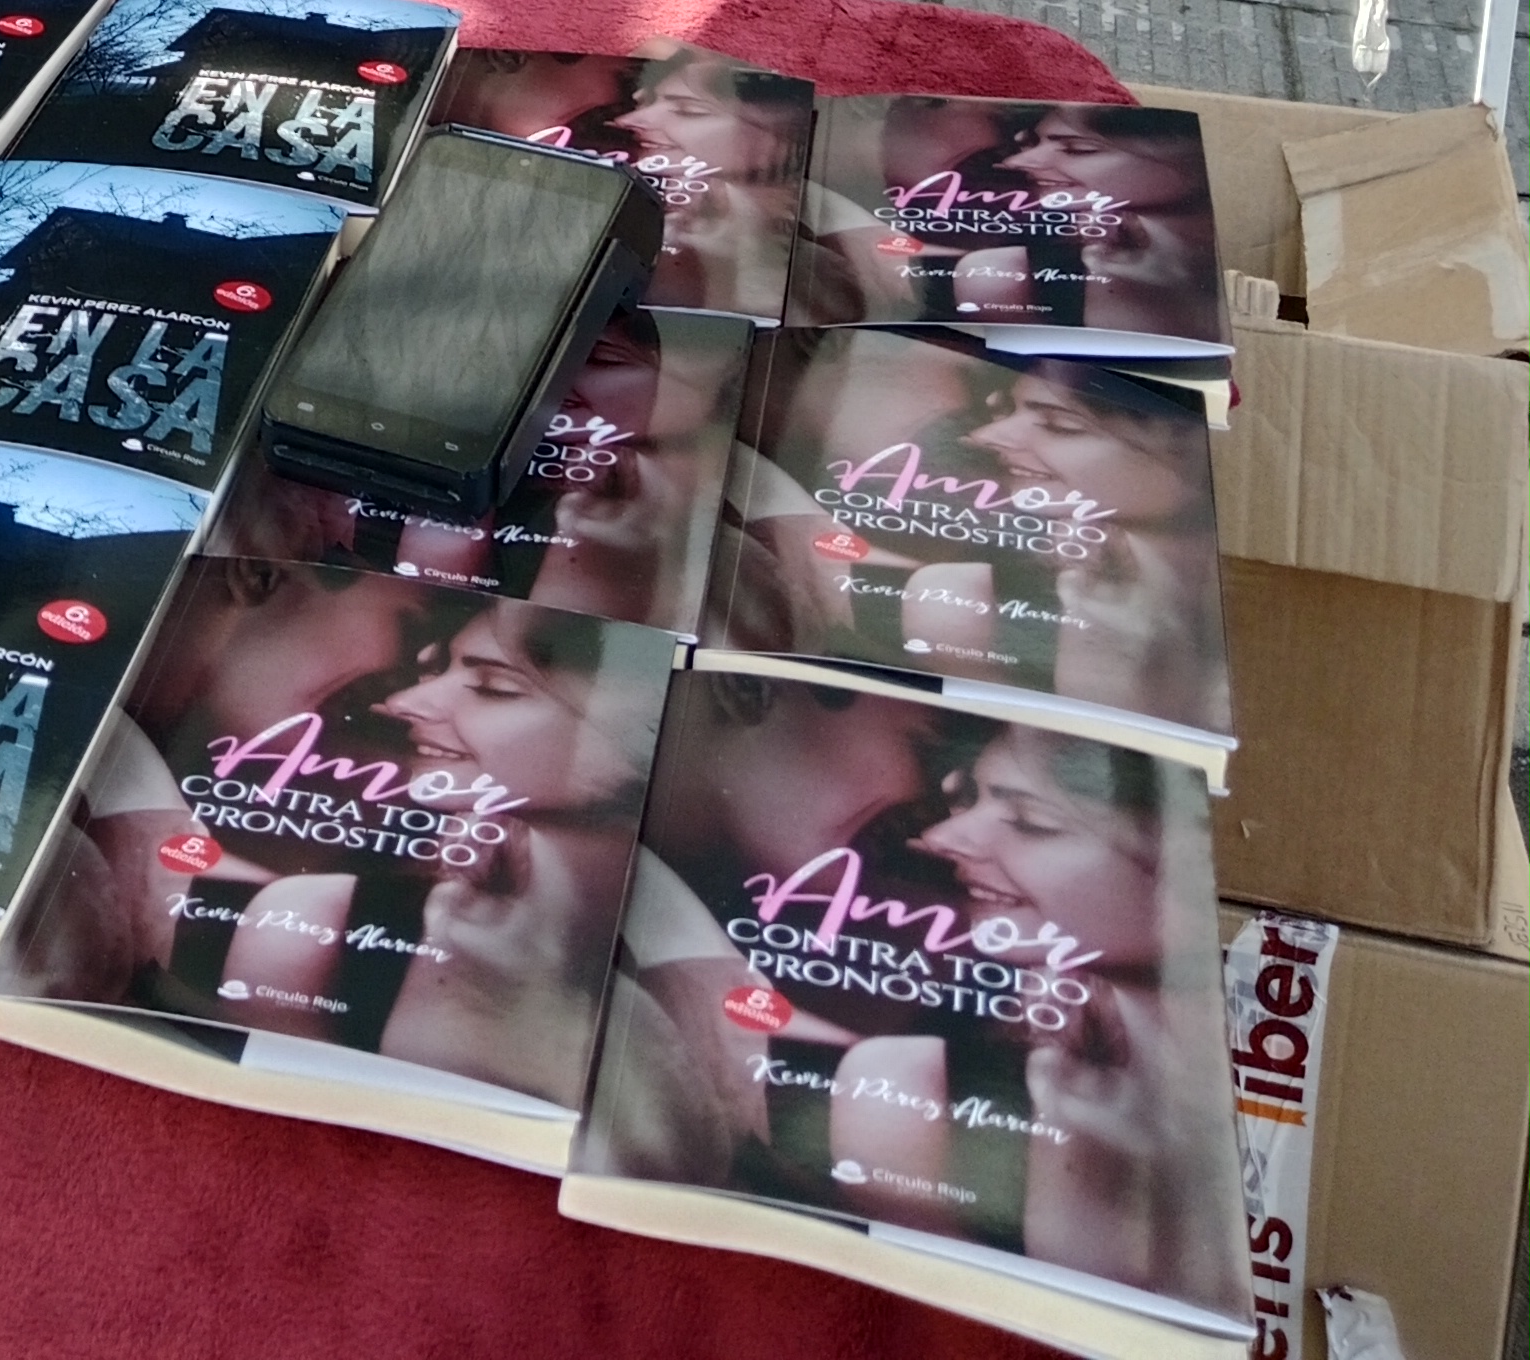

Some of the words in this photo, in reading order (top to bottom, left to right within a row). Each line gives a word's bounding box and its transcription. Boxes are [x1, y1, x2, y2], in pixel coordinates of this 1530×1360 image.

[198, 69, 246, 79] KEVIN
[176, 77, 278, 114] EN
[295, 89, 375, 128] LA
[151, 109, 374, 183] CASA
[874, 207, 1014, 222] CONTRA
[1021, 210, 1122, 226] TODO
[883, 170, 1130, 218] Amor
[890, 220, 1107, 238] PRONÓSTICO
[28, 293, 81, 307] KEVIN
[84, 298, 141, 315] PÉREZ
[144, 306, 230, 331] ALARCÓN
[132, 320, 229, 375] LA
[182, 452, 207, 467] Rojo
[826, 442, 1117, 521] Amor
[814, 488, 980, 525] CONTRA
[989, 510, 1107, 543] TODO
[832, 508, 1087, 559] PRONÓSTICO
[207, 712, 531, 816] Amor
[181, 774, 363, 823] CONTRA
[376, 802, 507, 845] TODO
[190, 801, 478, 868] PRONÓSTICO
[166, 892, 251, 928] Kevin
[744, 847, 1105, 971] Amor
[727, 917, 933, 978] CONTRA
[943, 953, 1090, 1007] TODO
[312, 994, 349, 1013] Rojo
[747, 948, 1066, 1032] PRONÓSTICO
[746, 1053, 847, 1097] Kevin
[937, 1182, 977, 1204] Rojo
